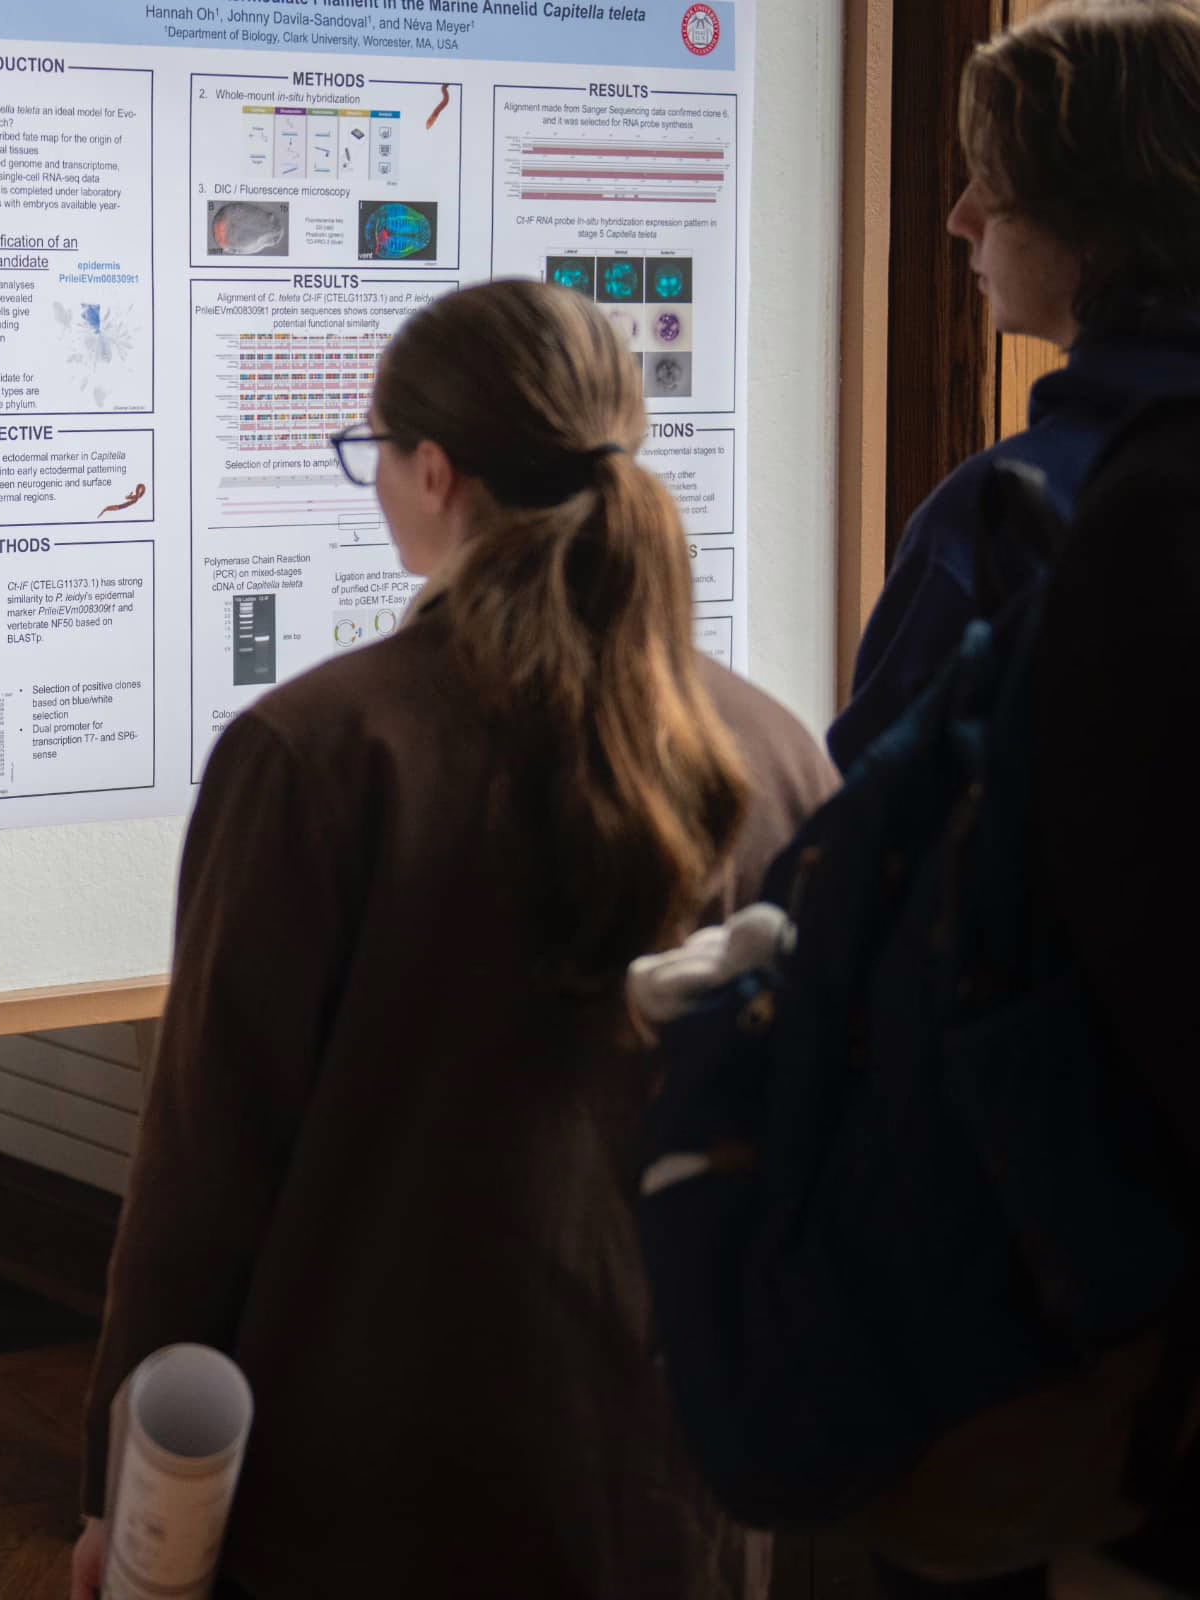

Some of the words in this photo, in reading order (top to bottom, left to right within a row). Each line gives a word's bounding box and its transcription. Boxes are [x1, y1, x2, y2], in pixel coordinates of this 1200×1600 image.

[144, 4, 194, 20] Hannah
[226, 8, 270, 27] Johnny
[378, 16, 400, 30] and
[401, 0, 424, 11] the
[429, 0, 478, 13] Marine
[482, 0, 537, 16] Annelid
[542, 1, 605, 23] Capitella
[608, 4, 646, 22] teleta
[240, 29, 281, 45] Biology,
[282, 31, 308, 43] Clark
[436, 38, 458, 50] USA
[292, 71, 365, 88] METHODS
[214, 88, 275, 101] Whole-mount
[305, 92, 361, 106] hybridization
[588, 82, 649, 98] RESULTS
[42, 107, 53, 115] an
[54, 106, 75, 116] ideal
[76, 107, 103, 117] model
[104, 107, 115, 118] for
[22, 131, 39, 142] fate
[39, 134, 59, 144] map
[60, 132, 72, 143] for
[73, 133, 87, 143] the
[88, 135, 112, 146] origin
[8, 144, 39, 155] tissues
[7, 159, 43, 171] genome
[44, 159, 60, 169] and
[41, 171, 81, 185] RNA-seq
[81, 173, 100, 183] data
[9, 185, 54, 197] completed
[54, 187, 78, 196] under
[79, 186, 122, 199] laboratory
[213, 183, 232, 194] DIC
[238, 183, 300, 196] Fluorescence
[300, 185, 351, 199] microscopy
[3, 198, 21, 208] with
[22, 198, 59, 211] embryos
[60, 198, 97, 210] available
[47, 234, 59, 250] of
[62, 238, 78, 251] an
[292, 273, 359, 289] RESULTS
[272, 318, 307, 329] potential
[307, 317, 346, 328] functional
[345, 318, 380, 330] similarity
[22, 372, 33, 382] for
[16, 478, 63, 491] neurogenic
[64, 478, 80, 487] and
[81, 476, 112, 487] surface
[203, 555, 251, 569] Polymerase
[251, 554, 275, 565] Chain
[275, 553, 311, 563] Reaction
[212, 569, 238, 579] (PCR)
[238, 570, 249, 578] on
[250, 567, 303, 579] mixed-stages
[211, 581, 235, 591] cDNA
[6, 620, 49, 631] vertebrate
[50, 618, 74, 628] NF50
[75, 617, 101, 627] based
[102, 618, 113, 626] on
[31, 683, 71, 695] Selection
[81, 680, 114, 694] positive
[114, 679, 141, 690] clones
[31, 697, 58, 708] based
[59, 698, 71, 706] on
[70, 694, 114, 705] blue/white
[31, 710, 69, 721] selection
[32, 723, 52, 734] Dual
[52, 721, 91, 734] promoter
[91, 719, 103, 730] for
[31, 734, 83, 748] transcription
[100, 732, 116, 742] and
